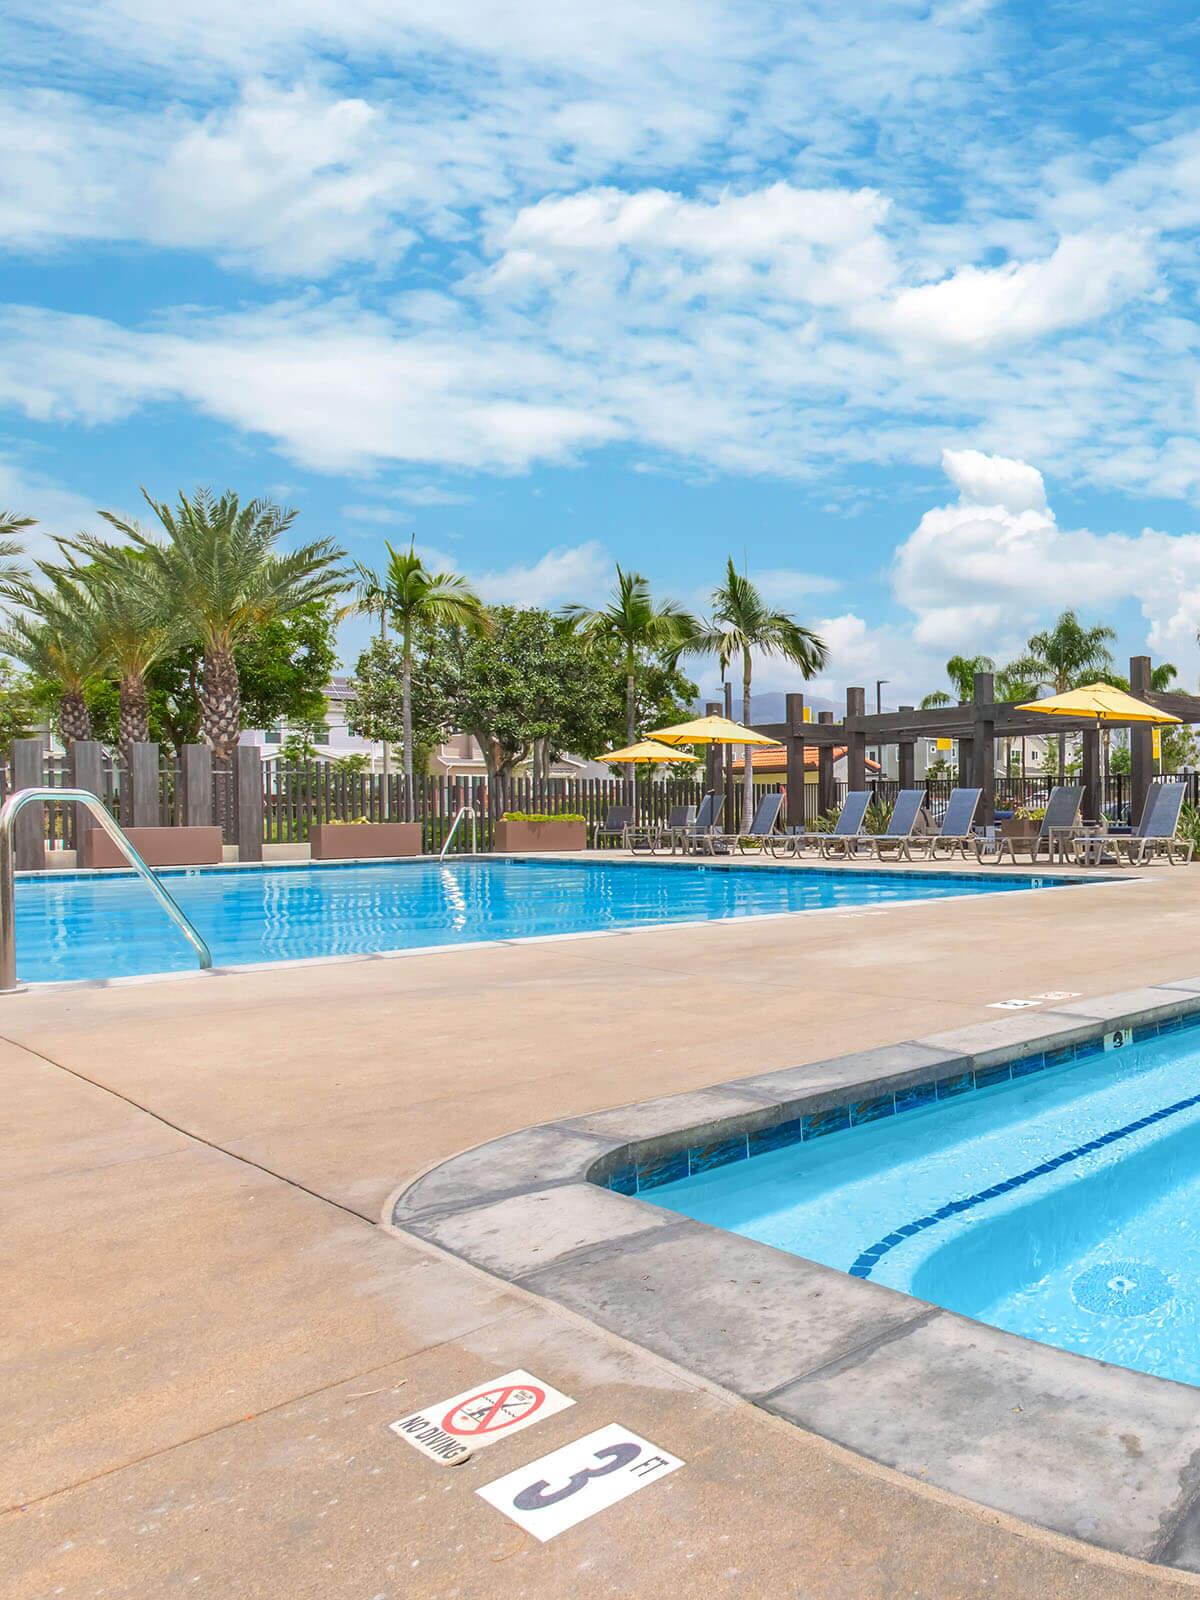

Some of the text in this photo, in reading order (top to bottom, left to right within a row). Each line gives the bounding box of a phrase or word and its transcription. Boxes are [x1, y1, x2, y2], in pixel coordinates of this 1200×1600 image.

[398, 1415, 467, 1459] NO DIVING
[513, 1442, 670, 1511] 3 FT
